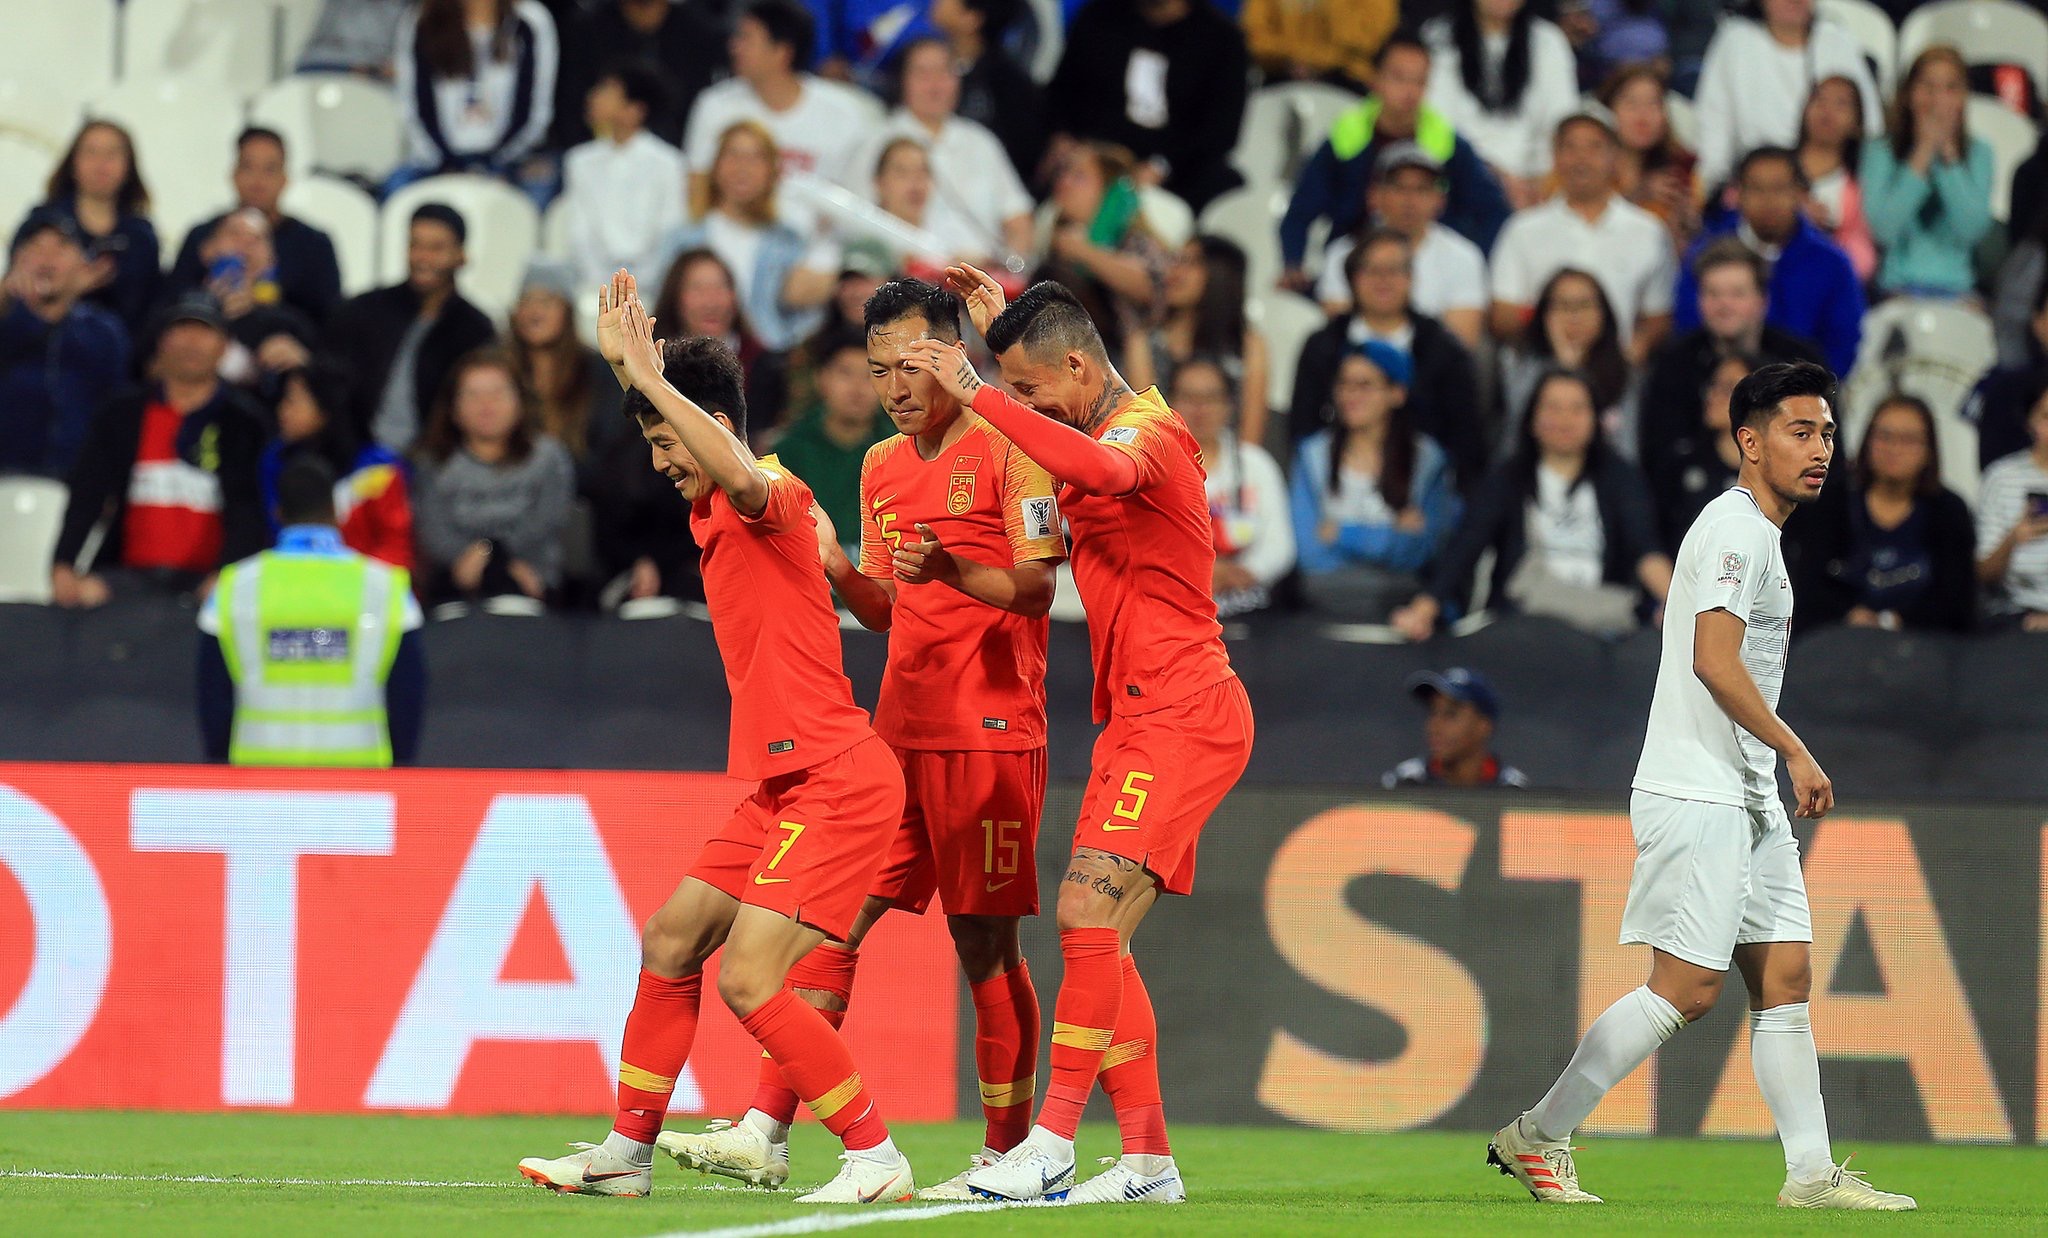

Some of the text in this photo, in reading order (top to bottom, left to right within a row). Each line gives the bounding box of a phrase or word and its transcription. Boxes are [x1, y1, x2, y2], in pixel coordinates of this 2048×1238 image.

[952, 477, 973, 486] CFA
[1112, 769, 1155, 822] 5
[766, 819, 807, 871] 7
[981, 819, 1022, 874] 15
[1256, 805, 2048, 1145] STA
